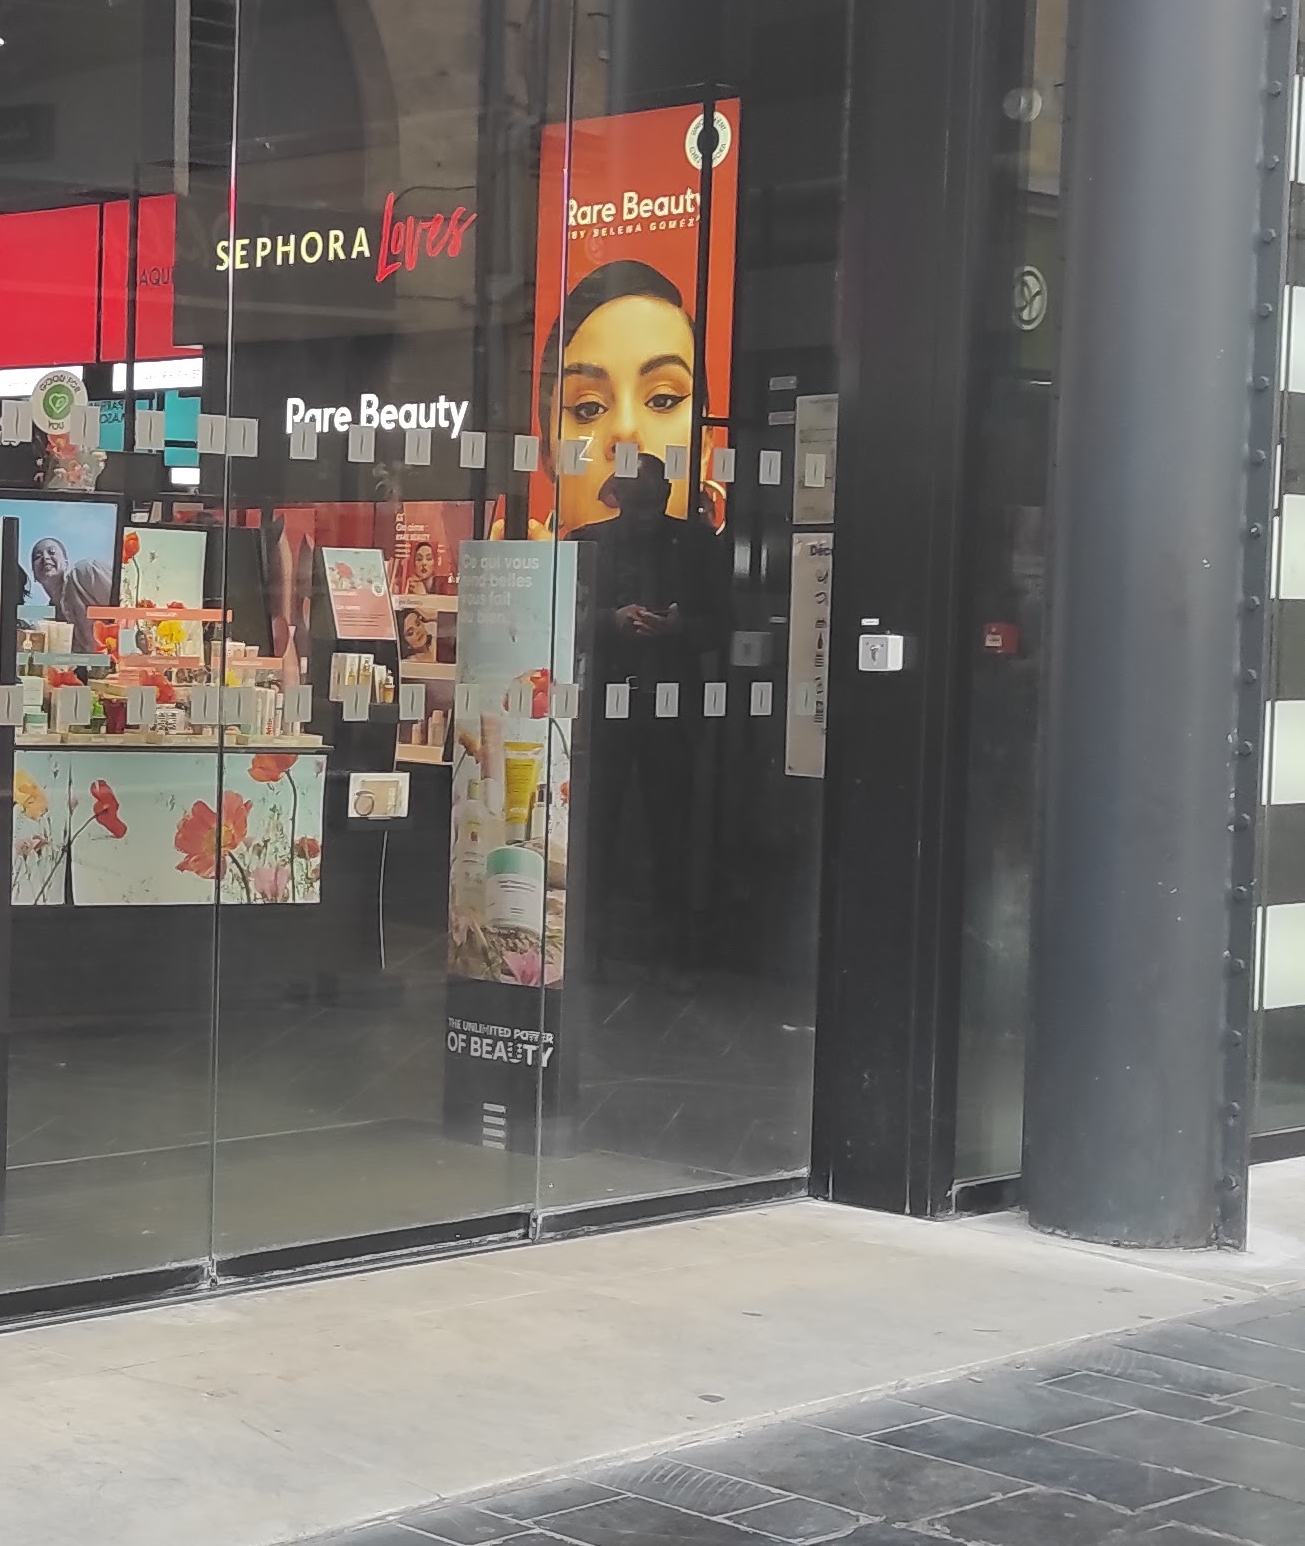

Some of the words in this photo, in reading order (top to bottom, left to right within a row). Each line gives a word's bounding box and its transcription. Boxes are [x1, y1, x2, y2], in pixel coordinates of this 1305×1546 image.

[216, 226, 371, 271] SEPHORA
[376, 191, 477, 283] Loves
[135, 266, 174, 287] AQU
[359, 393, 469, 439] Beauty
[504, 557, 540, 570] vous
[490, 572, 532, 588] belles
[448, 1031, 467, 1054] OF
[470, 1036, 554, 1068] BEAUTY
